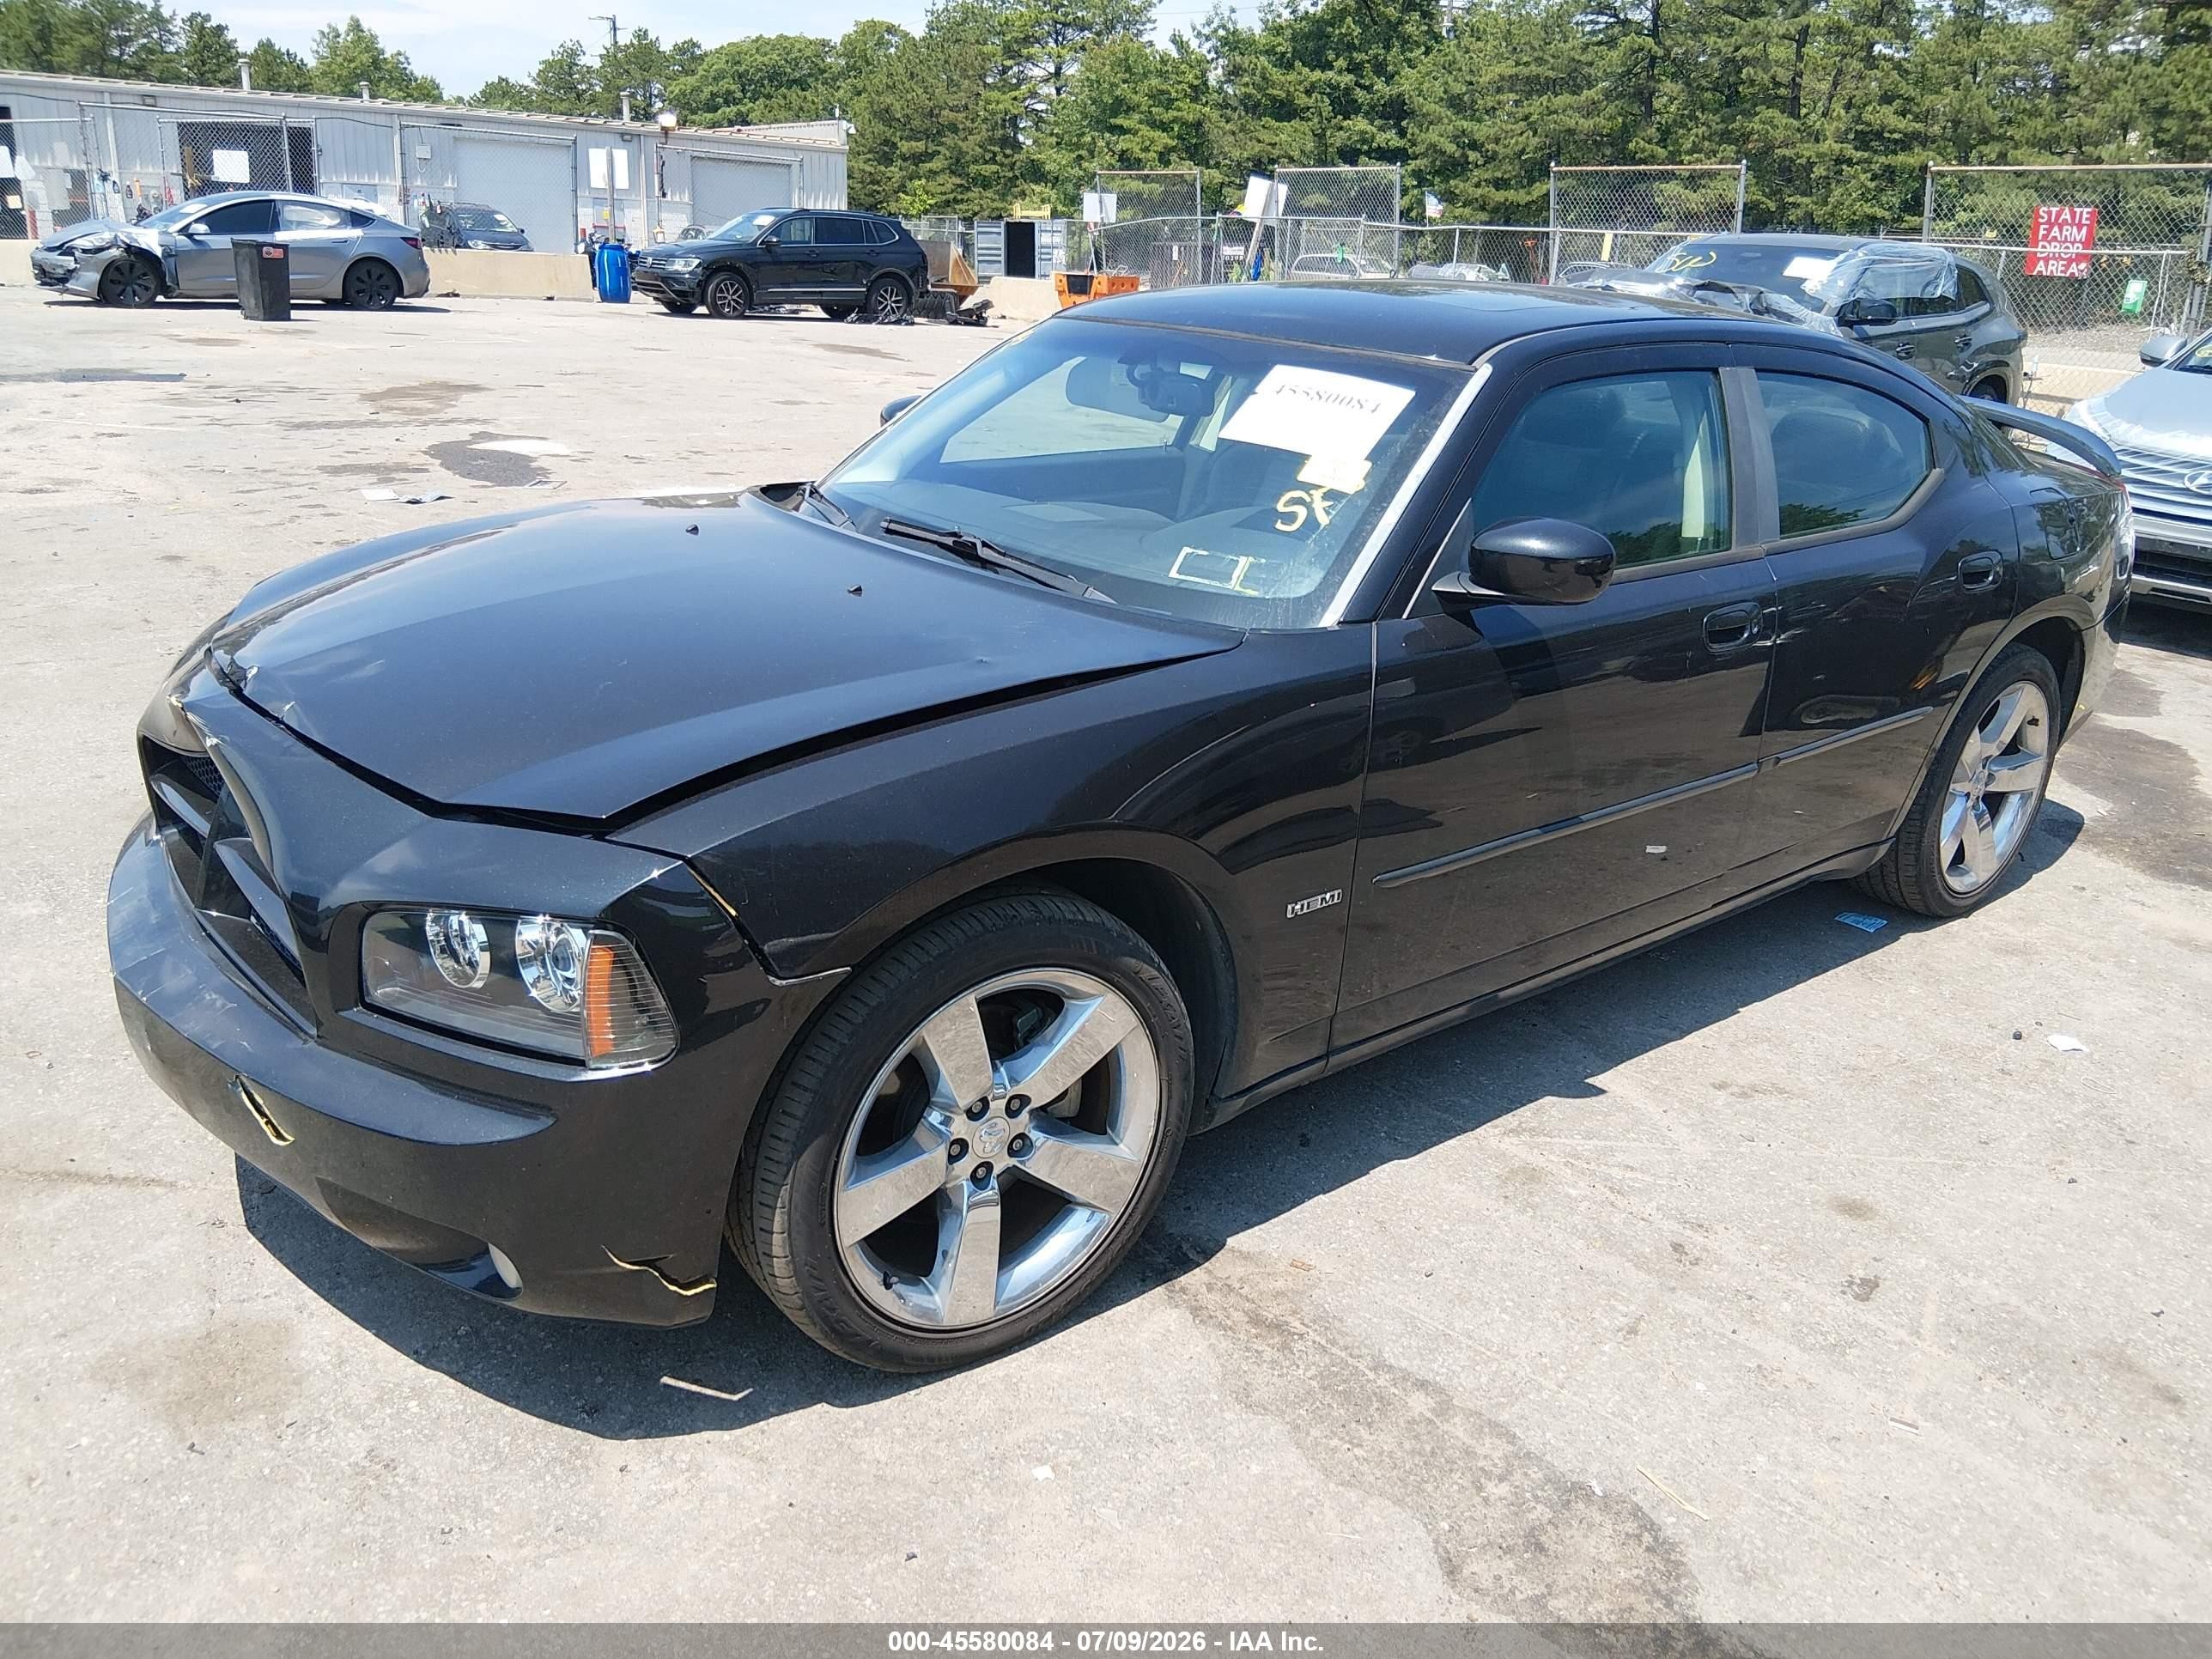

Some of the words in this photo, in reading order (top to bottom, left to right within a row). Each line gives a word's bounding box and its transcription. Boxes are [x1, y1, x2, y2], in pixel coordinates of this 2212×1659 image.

[2038, 207, 2091, 224] STATE
[2038, 224, 2087, 241] FARM
[2036, 241, 2084, 258] DROP
[2033, 259, 2080, 277] AREA
[1286, 888, 1343, 919] HEMI
